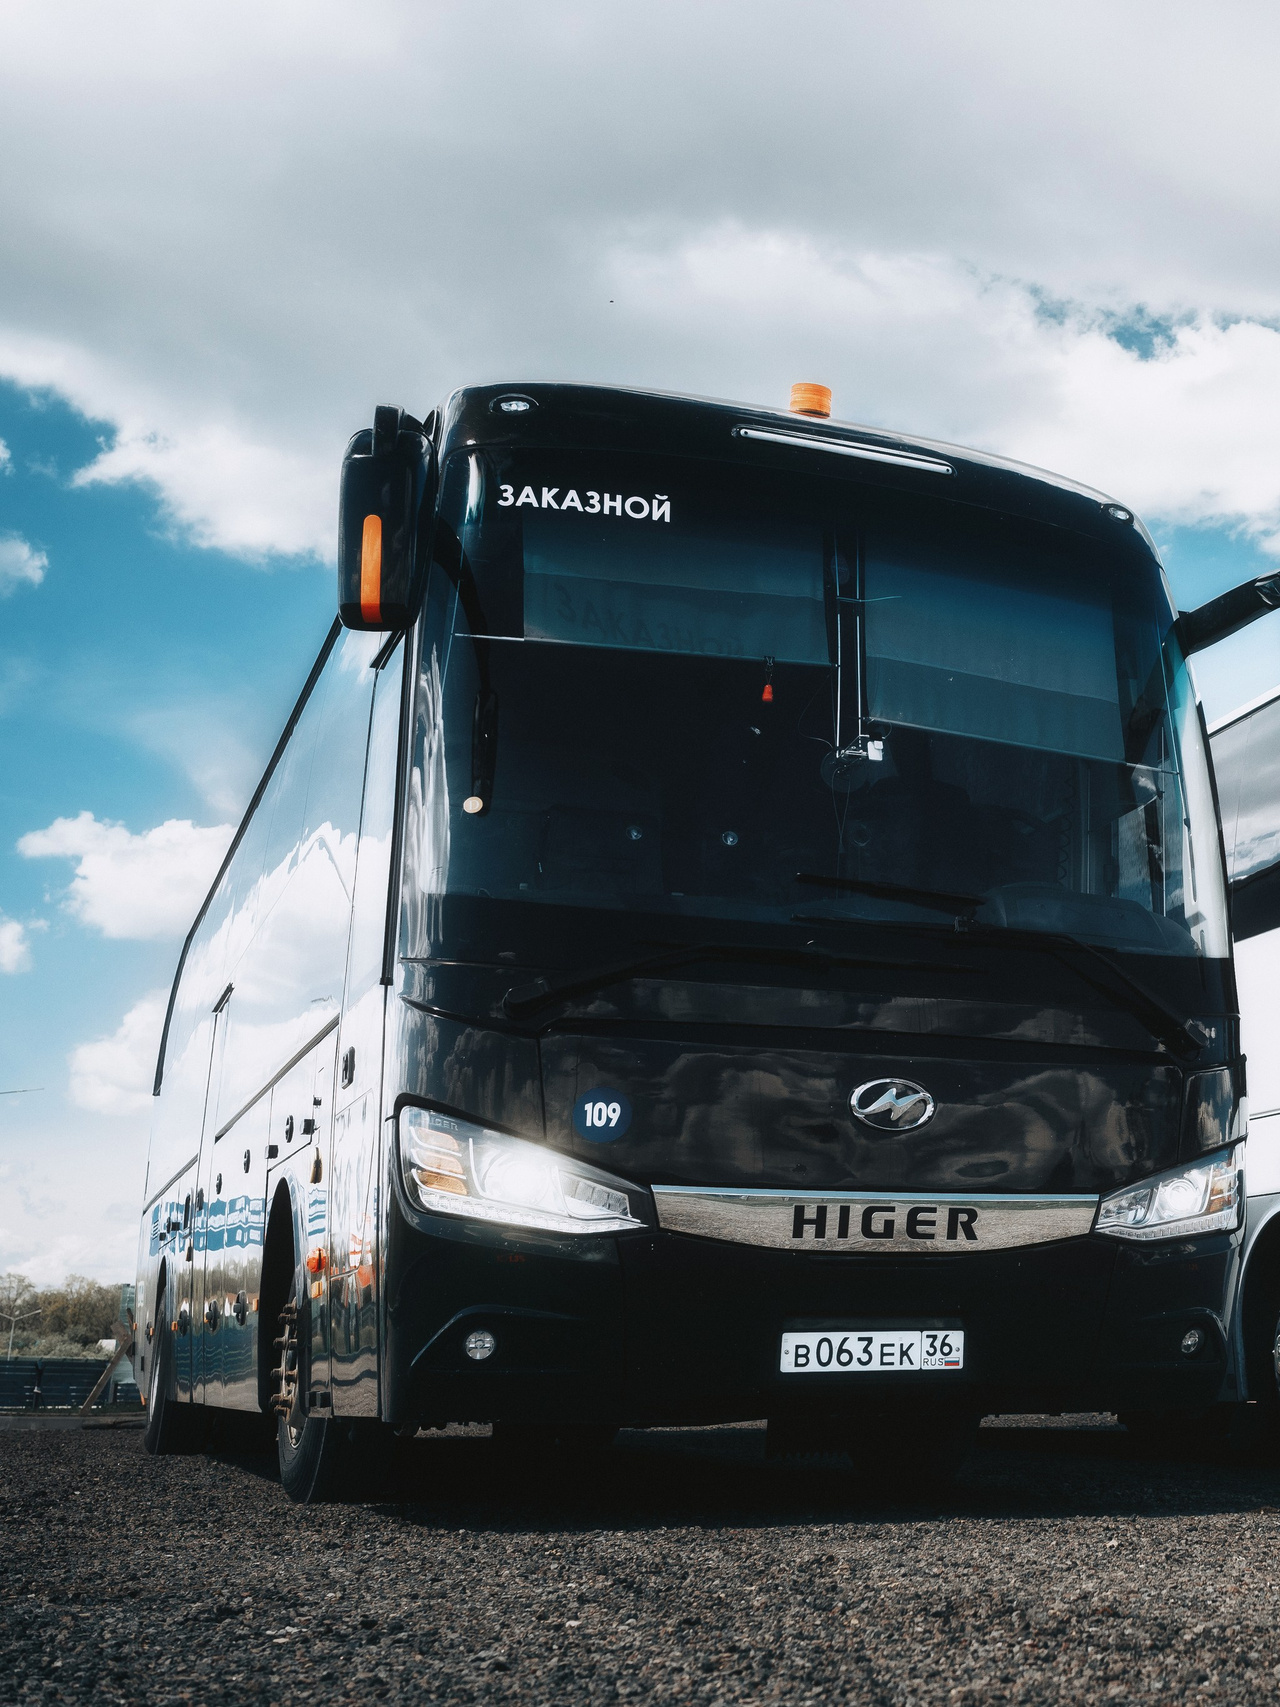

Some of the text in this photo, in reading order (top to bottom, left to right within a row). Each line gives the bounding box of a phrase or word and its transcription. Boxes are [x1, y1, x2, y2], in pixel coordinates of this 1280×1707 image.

[497, 484, 671, 523] ЗАКАЗНОЙ
[584, 1102, 621, 1127] 109
[792, 1205, 979, 1240] HIGER
[925, 1334, 953, 1357] 36
[923, 1357, 944, 1367] RUS
